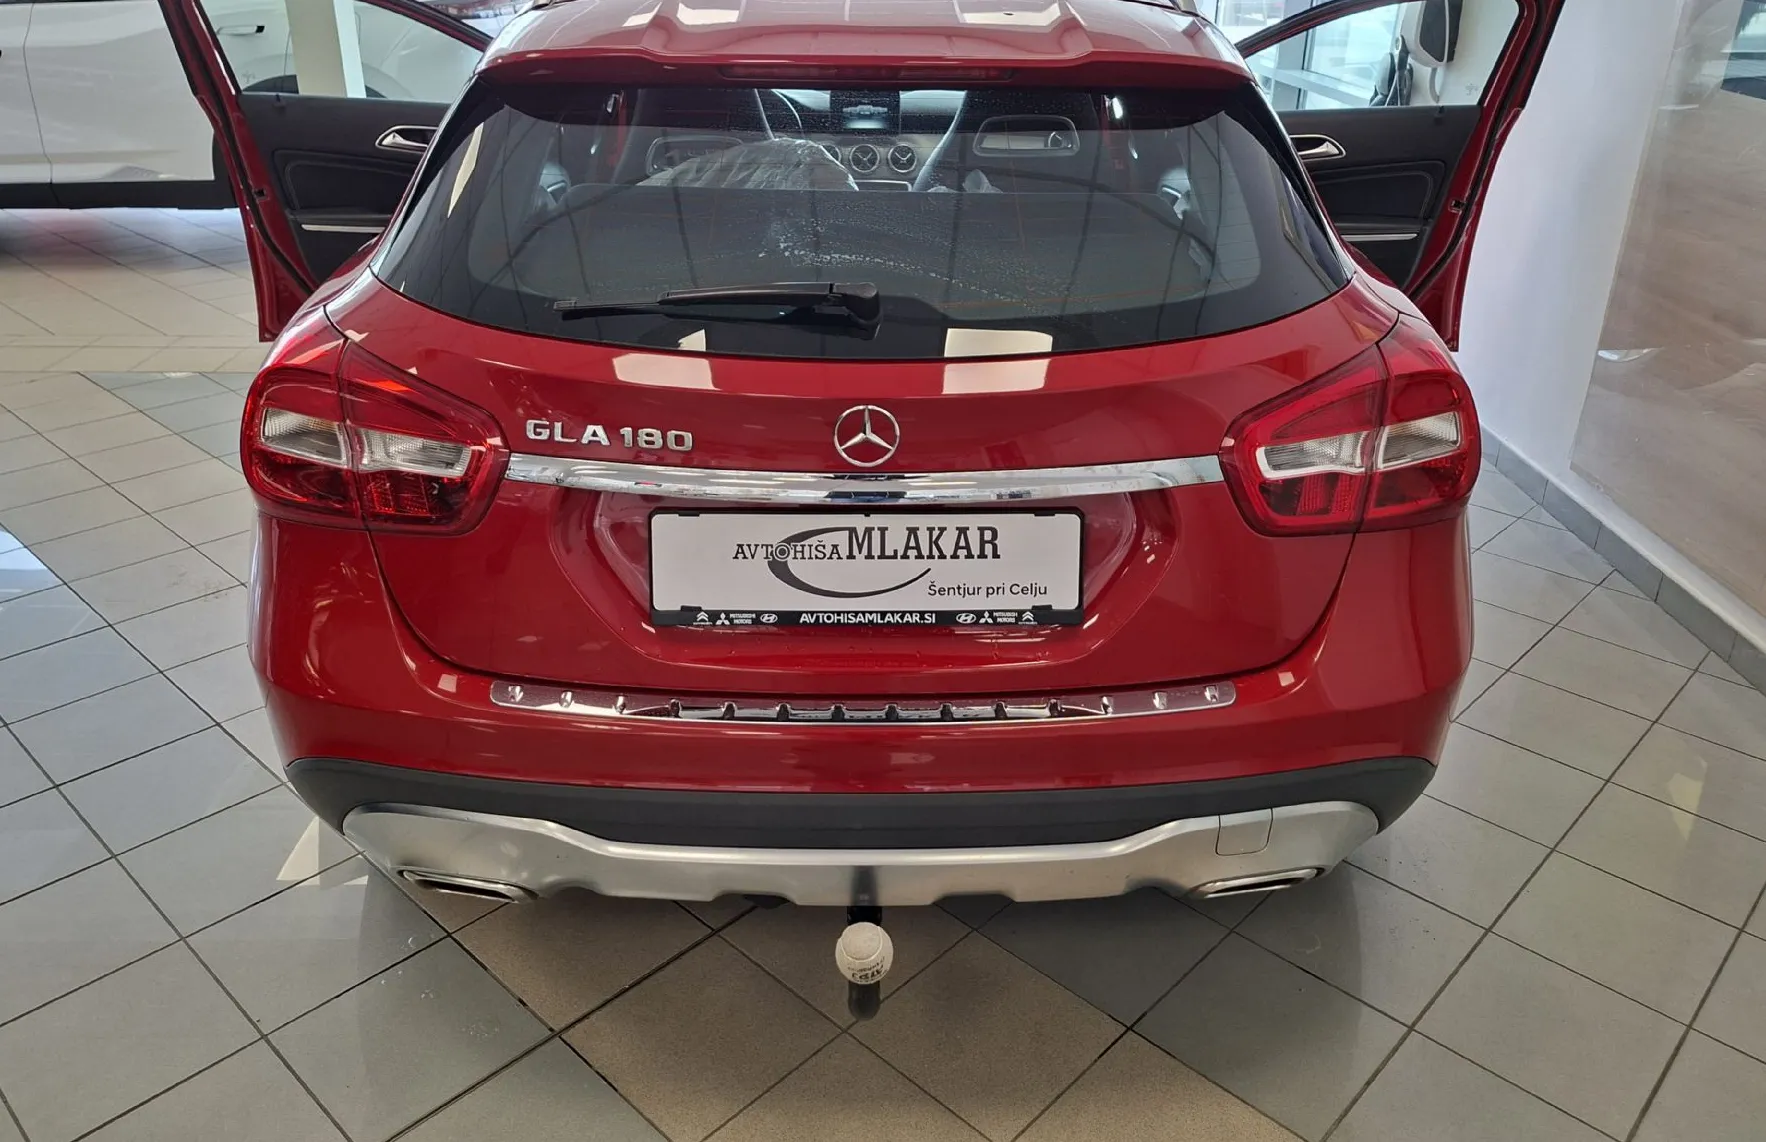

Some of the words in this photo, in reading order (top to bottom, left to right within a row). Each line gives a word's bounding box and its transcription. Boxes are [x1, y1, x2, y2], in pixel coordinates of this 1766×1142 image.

[526, 419, 610, 446] GLA
[619, 427, 693, 451] 180
[733, 540, 843, 561] AVTOHIŠA
[846, 526, 1000, 560] MLAKAR
[928, 580, 982, 597] Šentjur
[986, 583, 1005, 597] pri
[1009, 582, 1047, 597] Celju
[800, 612, 936, 624] AVTOHISAMLAKAR.SI
